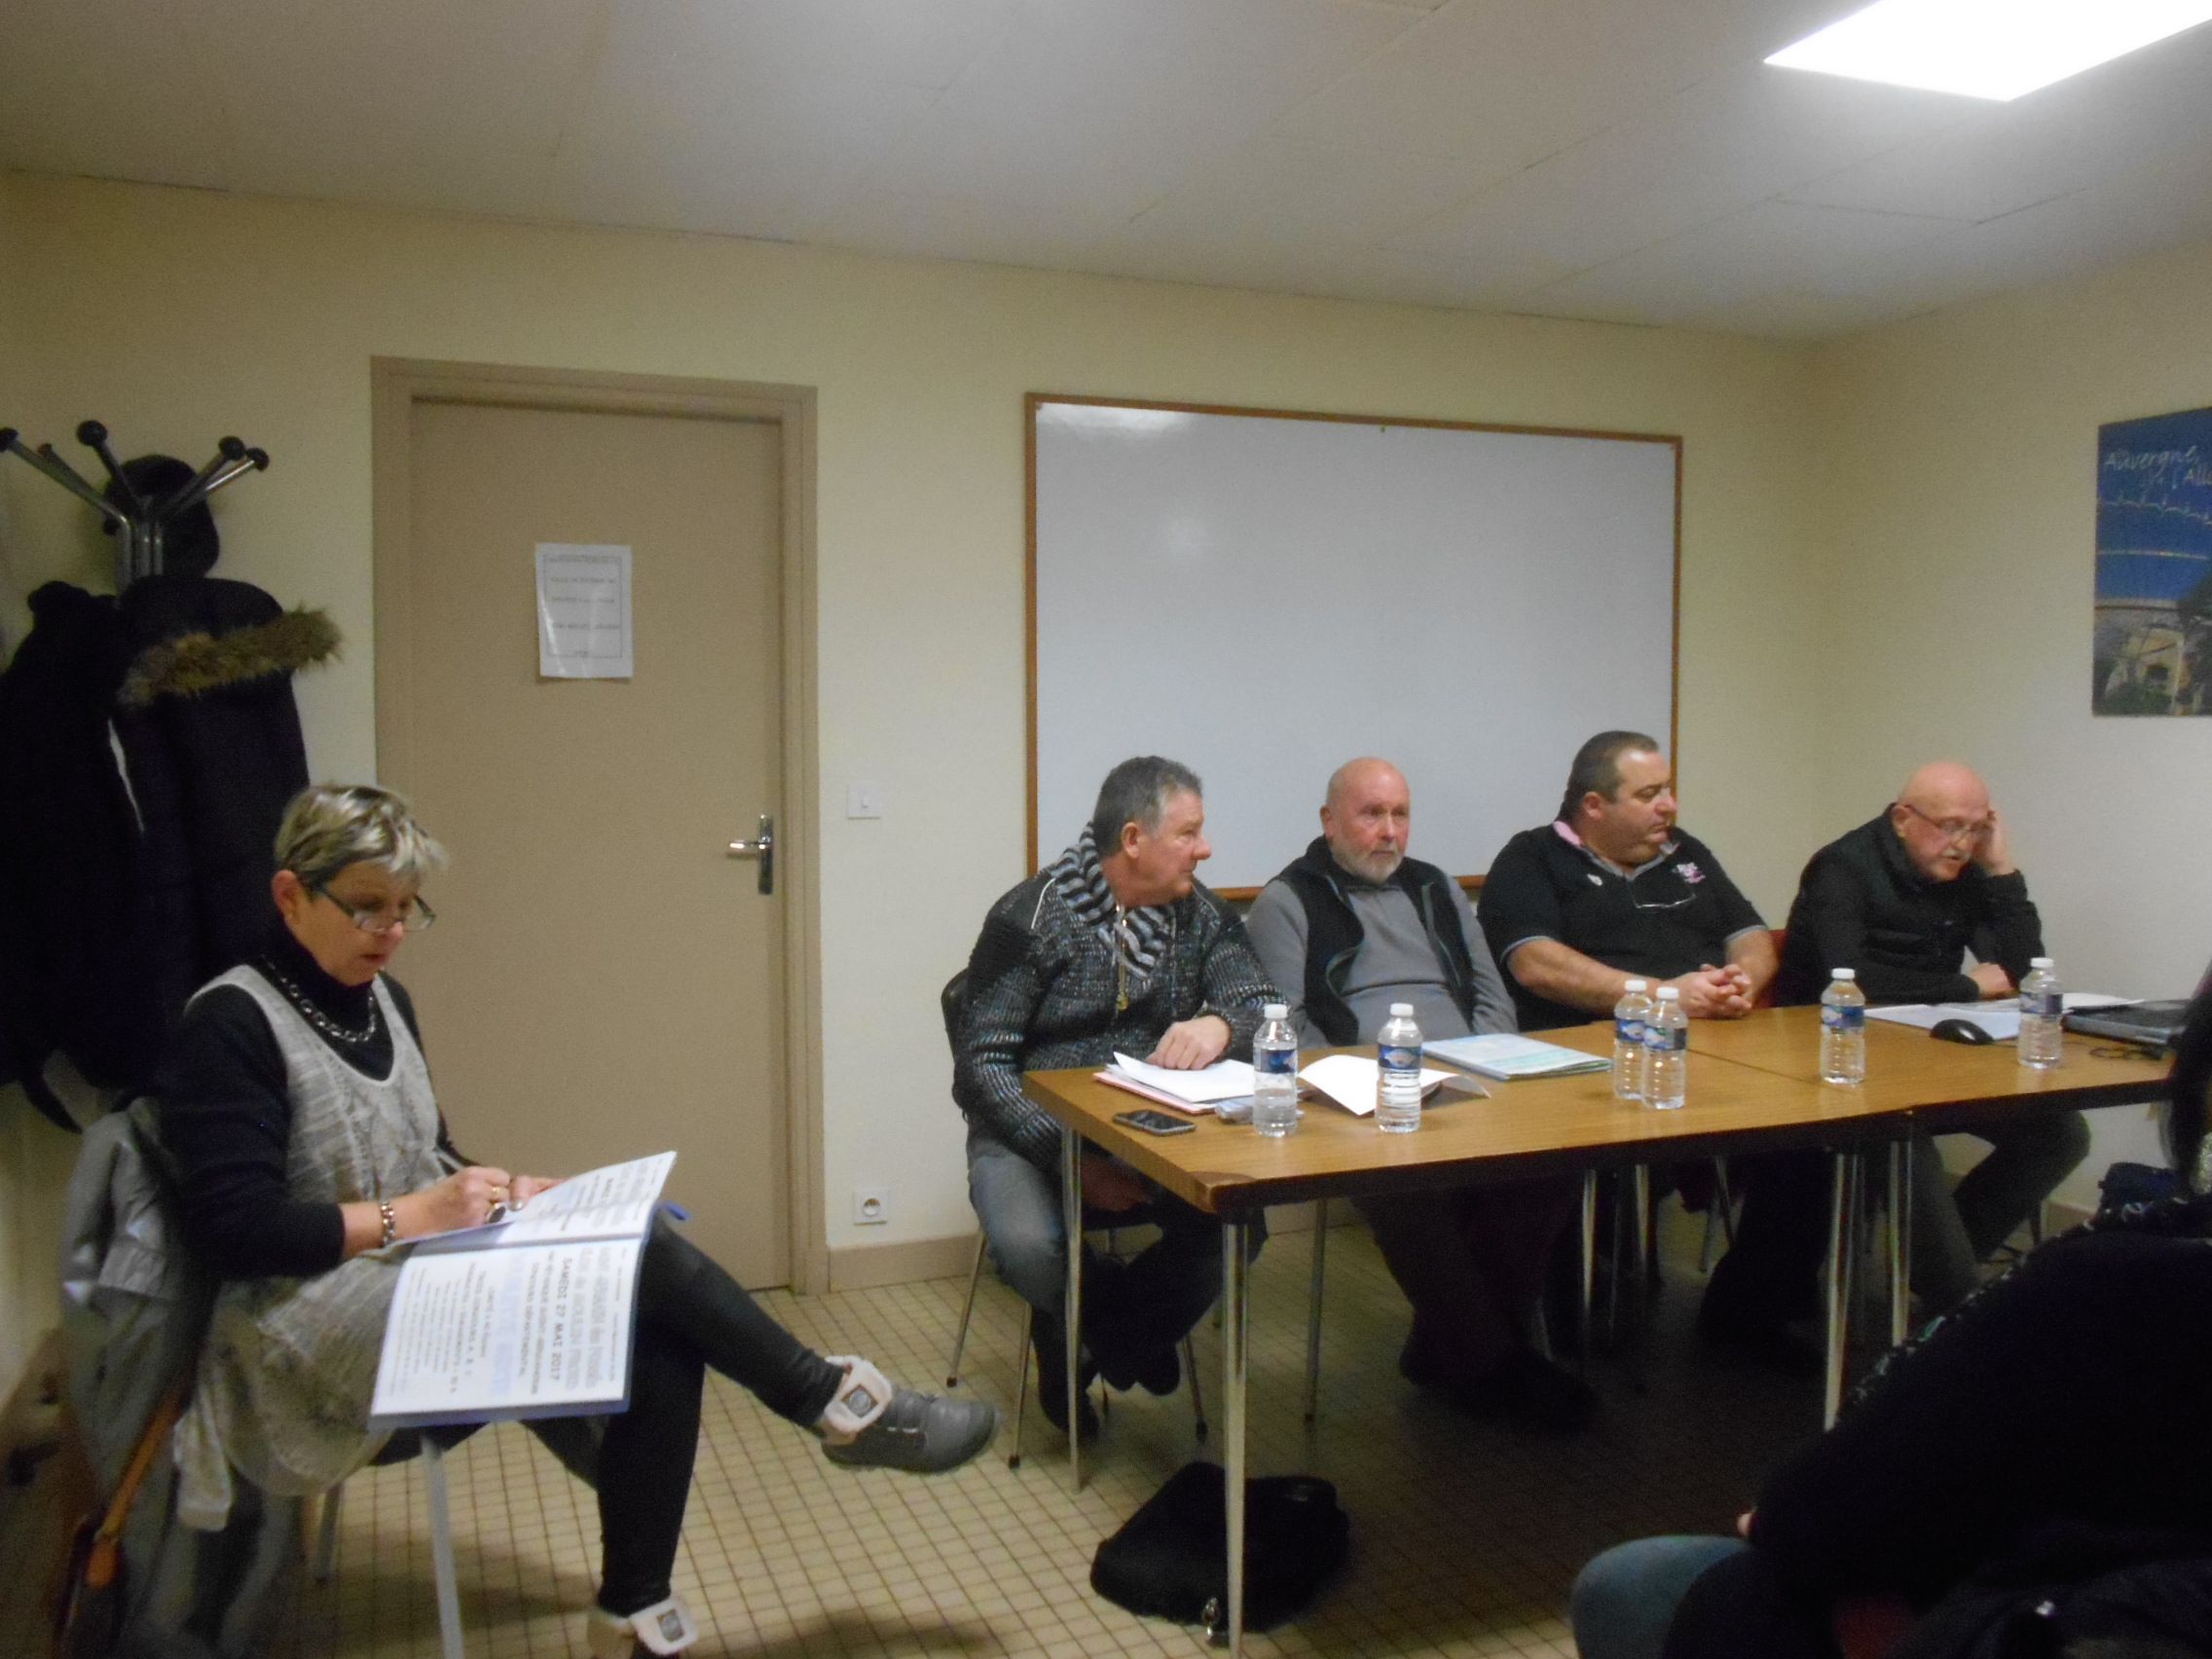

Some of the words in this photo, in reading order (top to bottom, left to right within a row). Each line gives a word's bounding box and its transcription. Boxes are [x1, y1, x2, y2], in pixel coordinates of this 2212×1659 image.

[556, 1257, 572, 1299] SAMEDI
[552, 1322, 565, 1347] MAI
[548, 1352, 562, 1382] 2017
